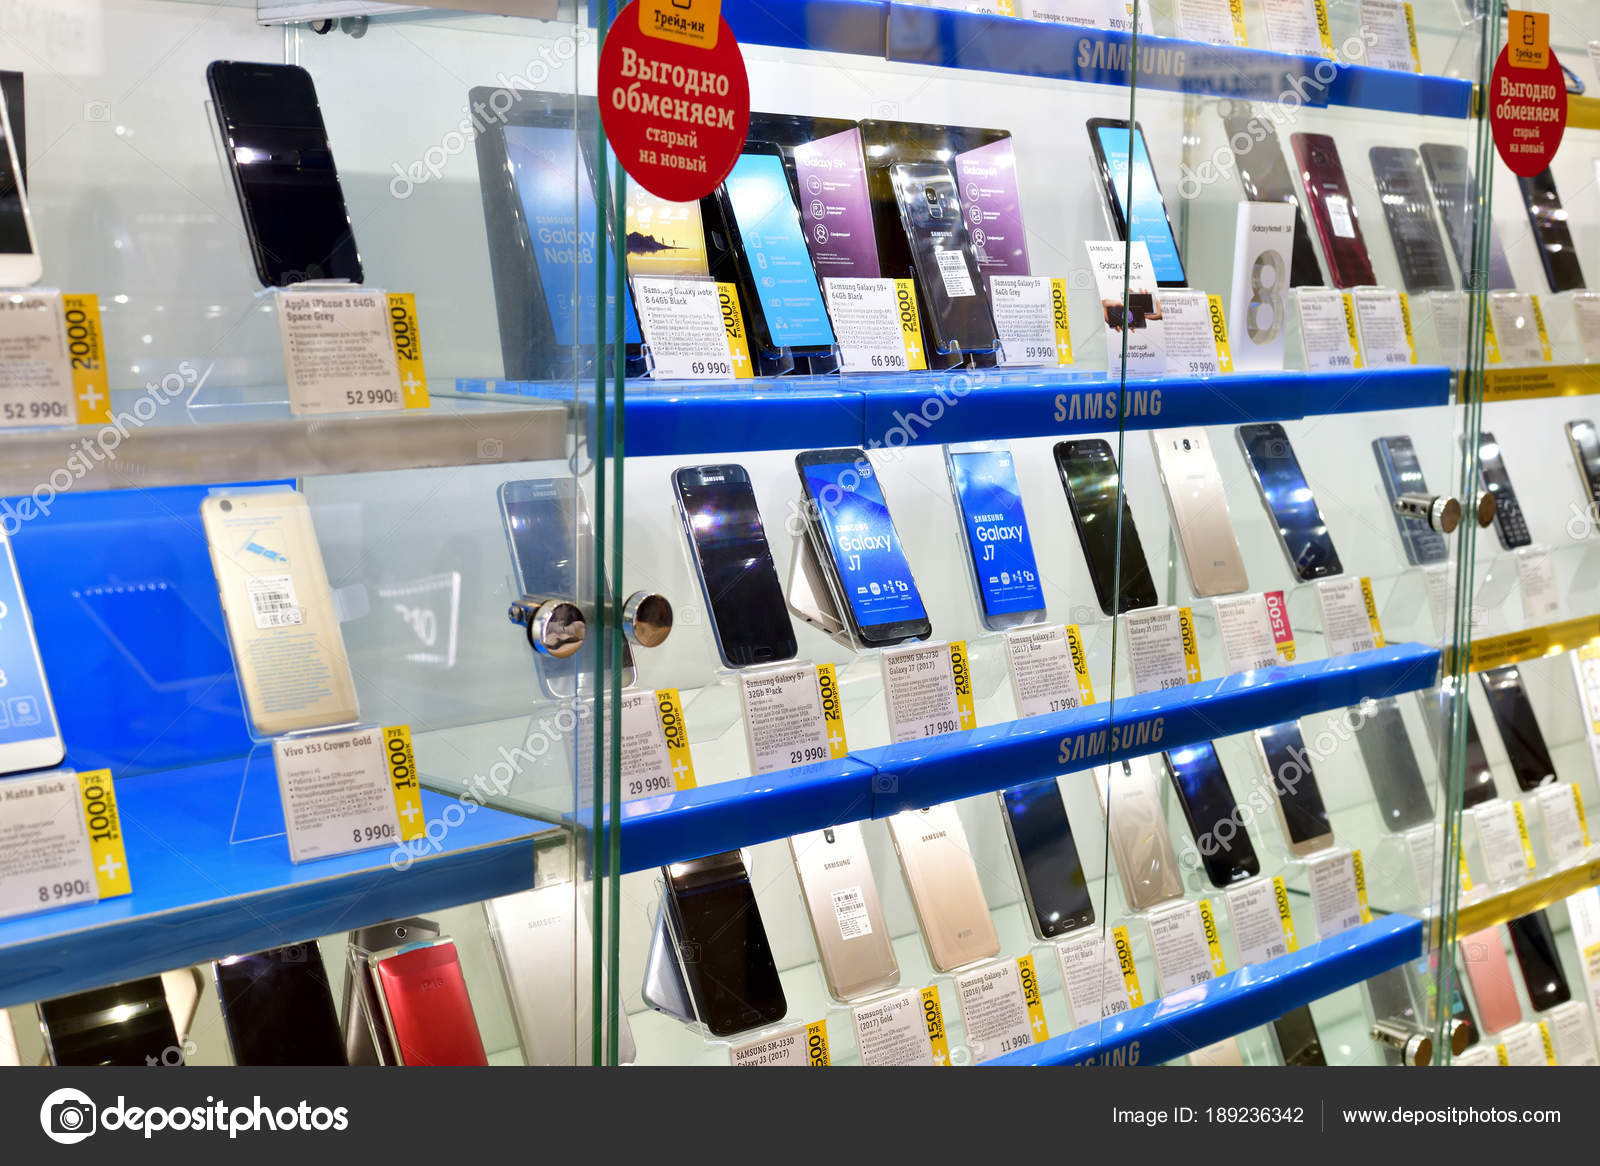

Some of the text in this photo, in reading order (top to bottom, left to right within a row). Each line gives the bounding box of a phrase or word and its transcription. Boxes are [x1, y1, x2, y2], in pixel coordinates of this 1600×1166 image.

[654, 9, 705, 32] Трейд-ин
[1077, 37, 1186, 78] SAMSUNG
[620, 47, 729, 97] Выгодно
[1500, 76, 1556, 103] Выгодно
[612, 81, 735, 130] обменяем
[1495, 99, 1560, 123] обменяем
[645, 127, 698, 149] старый
[1513, 126, 1540, 141] старый
[1509, 142, 1545, 154] на новый
[638, 149, 707, 173] на новый
[804, 156, 833, 171] Galaxy
[963, 166, 988, 178] Galaxy
[538, 228, 596, 248] Galaxy
[1251, 224, 1269, 234] Galaxy
[543, 246, 594, 265] Note8
[830, 283, 857, 292] Samsung
[857, 284, 876, 293] Galaxy
[994, 279, 1035, 288] Samsung Galaxy
[1009, 288, 1021, 297] Grey
[285, 297, 376, 311] Apple iPhone 8 64Gb
[644, 295, 688, 305] 8 64Gb Black
[832, 292, 864, 301] 64Gb Black
[287, 311, 335, 324] Space Grey
[719, 294, 738, 339] 2000
[897, 290, 915, 333] 2000
[1052, 289, 1065, 330] 2000
[1210, 304, 1224, 344] 2000
[65, 309, 92, 371] 2000
[392, 307, 413, 361] 2000
[871, 355, 902, 367] 66 990
[1026, 346, 1052, 358] 59 990
[692, 362, 727, 375] 69 990
[1189, 361, 1214, 373] 59 990
[347, 389, 393, 406] 52 990
[1054, 389, 1162, 422] SAMSUNG
[5, 401, 63, 420] 52 990
[973, 513, 1004, 524] SAMSUNG
[976, 524, 1024, 543] Galaxy
[839, 534, 893, 553] Galaxy
[983, 544, 995, 561] J7
[848, 554, 862, 572] J7
[1266, 596, 1288, 639] 1500
[1009, 632, 1049, 645] Samsung Galaxy
[1179, 617, 1193, 656] 2000
[1030, 643, 1041, 651] Blue
[1067, 635, 1084, 676] 2000
[887, 650, 939, 667] SAMSUNG SM-J730
[889, 661, 936, 678] Galaxy J7 (2017)
[951, 653, 967, 696] 2000
[746, 671, 805, 689] Samsung Galaxy S7
[1160, 677, 1185, 691] 15 990
[633, 697, 642, 707] S7
[748, 689, 765, 700] 32Gb
[819, 675, 837, 721] 2000
[830, 681, 840, 714] подарок
[1049, 697, 1077, 712] 17 990
[659, 701, 681, 750] 2000
[674, 707, 685, 742] подарок
[924, 720, 954, 736] 17 990
[283, 736, 372, 758] Vivo Y53 Crown Gold
[1058, 717, 1165, 764] SAMSUNG
[388, 738, 412, 791] 1000
[404, 743, 416, 780] подарок
[790, 746, 823, 764] 29 990
[6, 782, 65, 801] Matte Black
[629, 776, 667, 795] 29 990
[85, 786, 113, 843] 1000
[353, 824, 391, 843] 8 990
[922, 830, 947, 843] SAMSUNG
[824, 858, 851, 870] SAMSUNG
[38, 879, 84, 902] 8 990
[1274, 886, 1290, 920] 1000
[1201, 910, 1217, 946] 1000
[1115, 939, 1131, 977] 1500
[960, 967, 1009, 989] Samsung Galaxy J5
[963, 982, 994, 1000] (2016) Gold
[1020, 968, 1037, 1009] 1500
[857, 1007, 883, 1022] Samsung
[901, 998, 910, 1008] J3
[1111, 1000, 1125, 1013] 990
[860, 1014, 893, 1033] (2017) Gold
[923, 1000, 941, 1043] 1500
[735, 1036, 795, 1061] SAMSUNG SM-J330
[1000, 1033, 1029, 1053] 11 990
[759, 1048, 790, 1065] J3 (2017)
